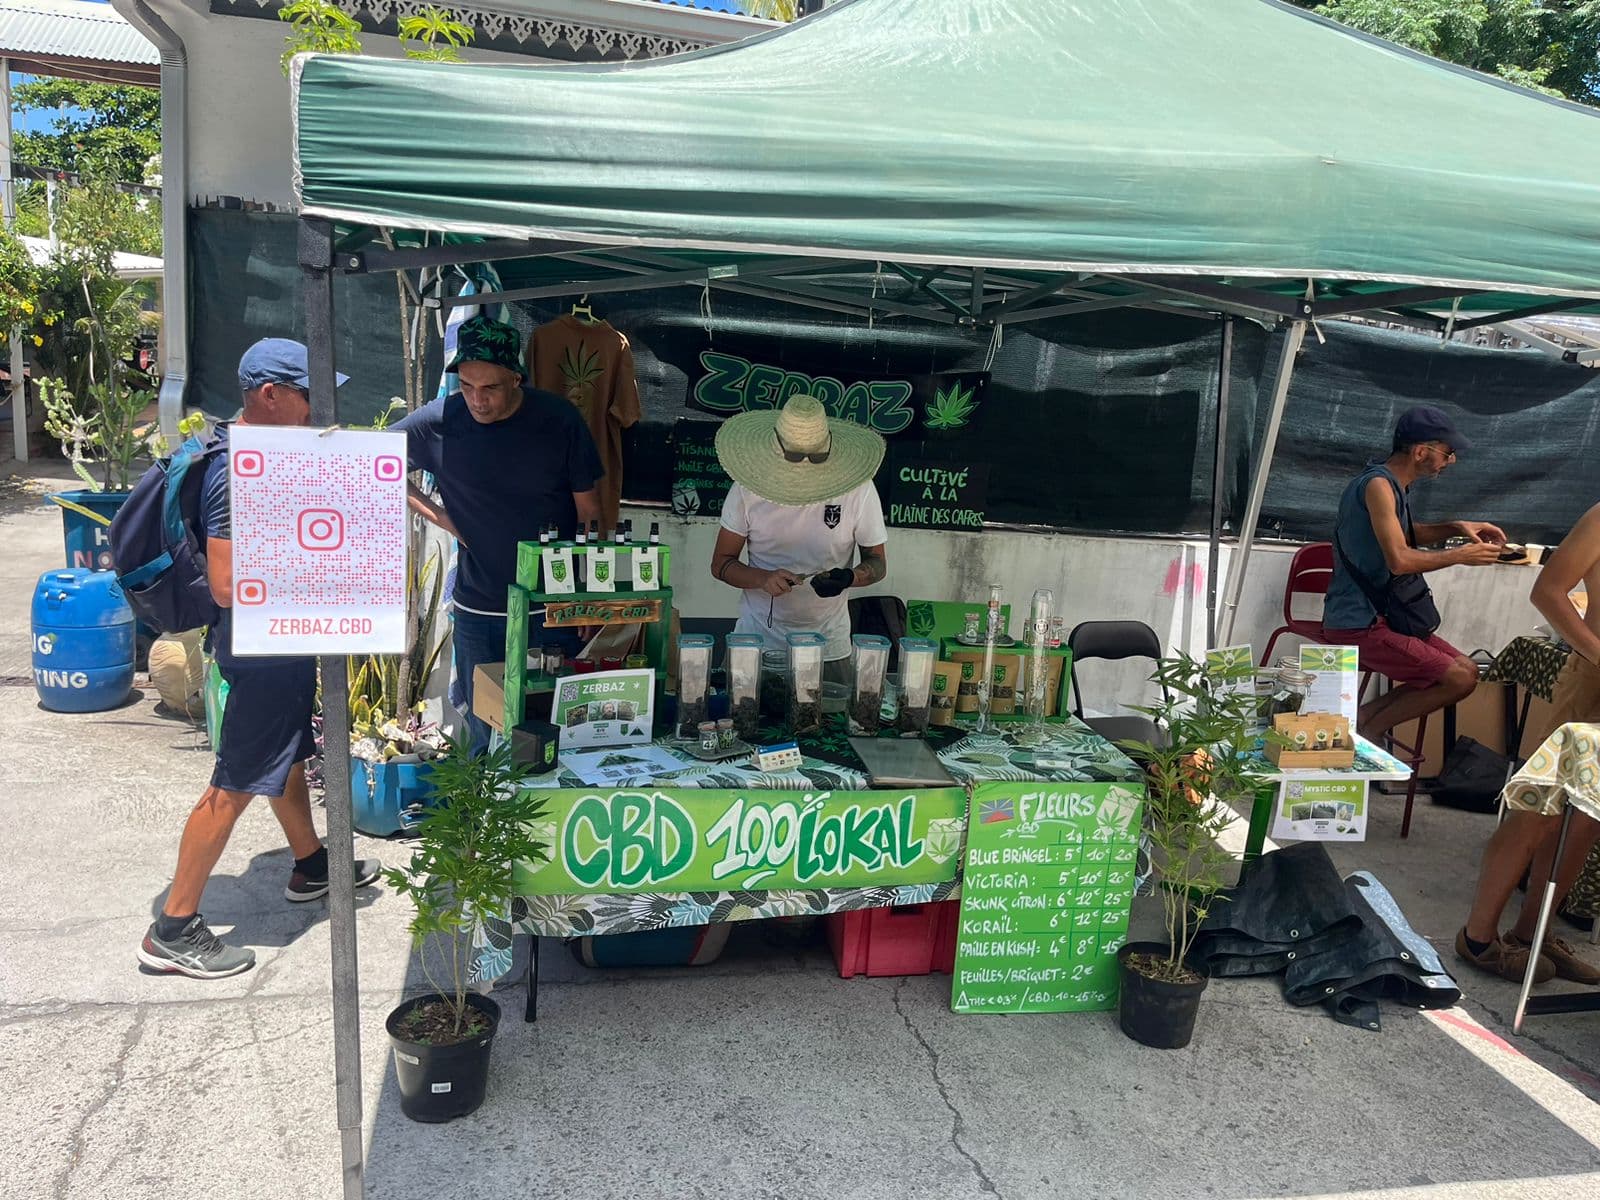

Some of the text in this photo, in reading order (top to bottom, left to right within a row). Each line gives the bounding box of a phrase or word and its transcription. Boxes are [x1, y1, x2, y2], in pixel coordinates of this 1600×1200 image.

[940, 486, 958, 502] LA
[932, 508, 950, 524] DES
[951, 509, 985, 526] CAFRES
[268, 617, 373, 636] ZERBAZ.CBD
[582, 681, 626, 695] ZERBAZ
[1304, 785, 1347, 793] MYSTIC CBD
[1020, 792, 1097, 823] FLEURS
[563, 791, 696, 889] CBD
[795, 795, 926, 884] LOKAL
[968, 848, 1000, 866] BLUE
[964, 895, 1008, 912] SKUNK
[991, 940, 1005, 956] EN
[969, 997, 986, 1006] THC
